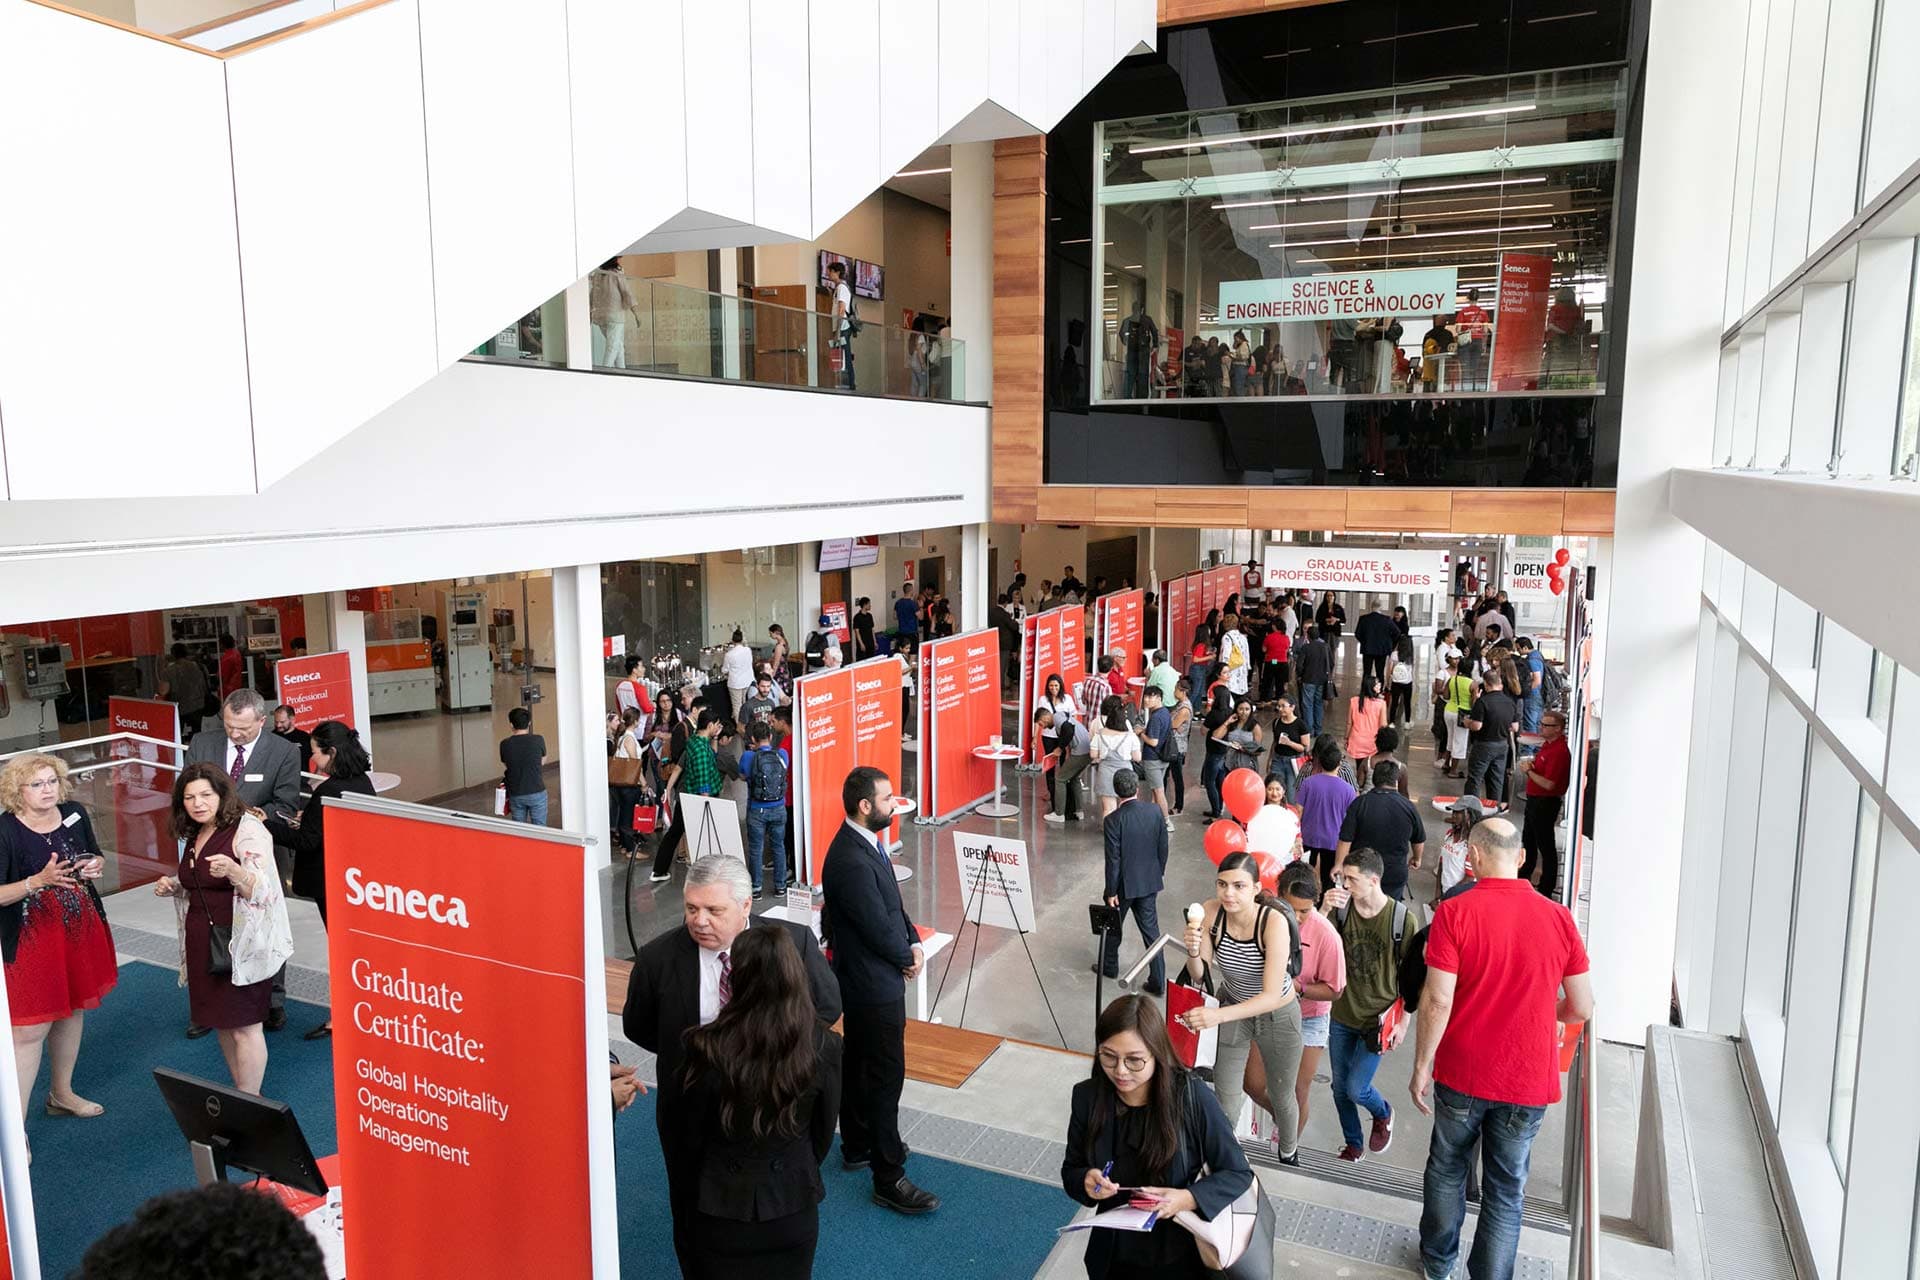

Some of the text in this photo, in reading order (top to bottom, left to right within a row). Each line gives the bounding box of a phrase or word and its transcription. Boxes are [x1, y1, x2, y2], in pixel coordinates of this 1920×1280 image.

[1503, 263, 1530, 273] Seneca
[1292, 278, 1375, 298] SCIENCE &
[1227, 293, 1445, 319] ENGINEERING TECHNOLOGY
[1307, 559, 1392, 572] GRADUATE &
[1513, 563, 1545, 576] OPEN
[1270, 569, 1431, 585] PROFESSIONAL STUDIES
[1513, 578, 1543, 590] HOUSE
[283, 671, 321, 685] Seneca
[856, 679, 882, 692] Seneca
[286, 689, 328, 705] Professional
[807, 692, 833, 707] Seneca
[115, 715, 149, 730] Seneca
[344, 866, 470, 928] Seneca
[351, 958, 464, 1014] Graduate
[353, 1001, 486, 1064] Certificate:
[356, 1058, 509, 1121] Global Hospitality
[357, 1086, 449, 1132] Operations
[359, 1114, 471, 1167] Management
